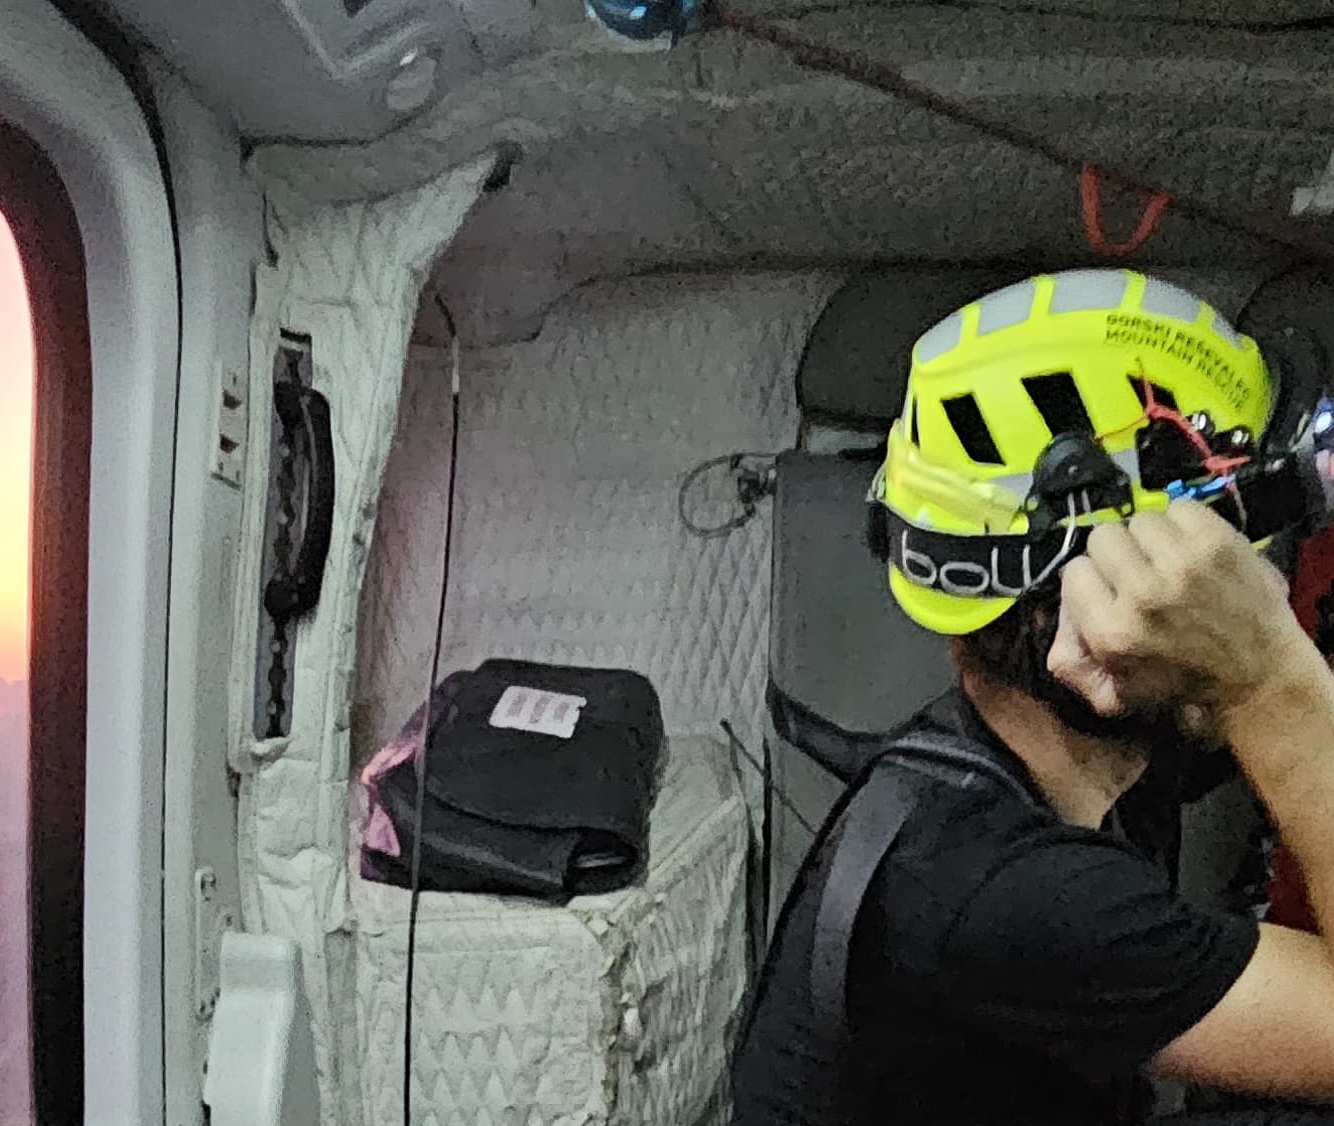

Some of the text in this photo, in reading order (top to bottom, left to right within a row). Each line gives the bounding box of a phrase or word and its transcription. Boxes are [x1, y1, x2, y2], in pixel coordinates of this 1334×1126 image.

[1107, 314, 1171, 338] GORSKI
[1107, 329, 1194, 364] MOUNTAIN
[901, 529, 1033, 598] boll
